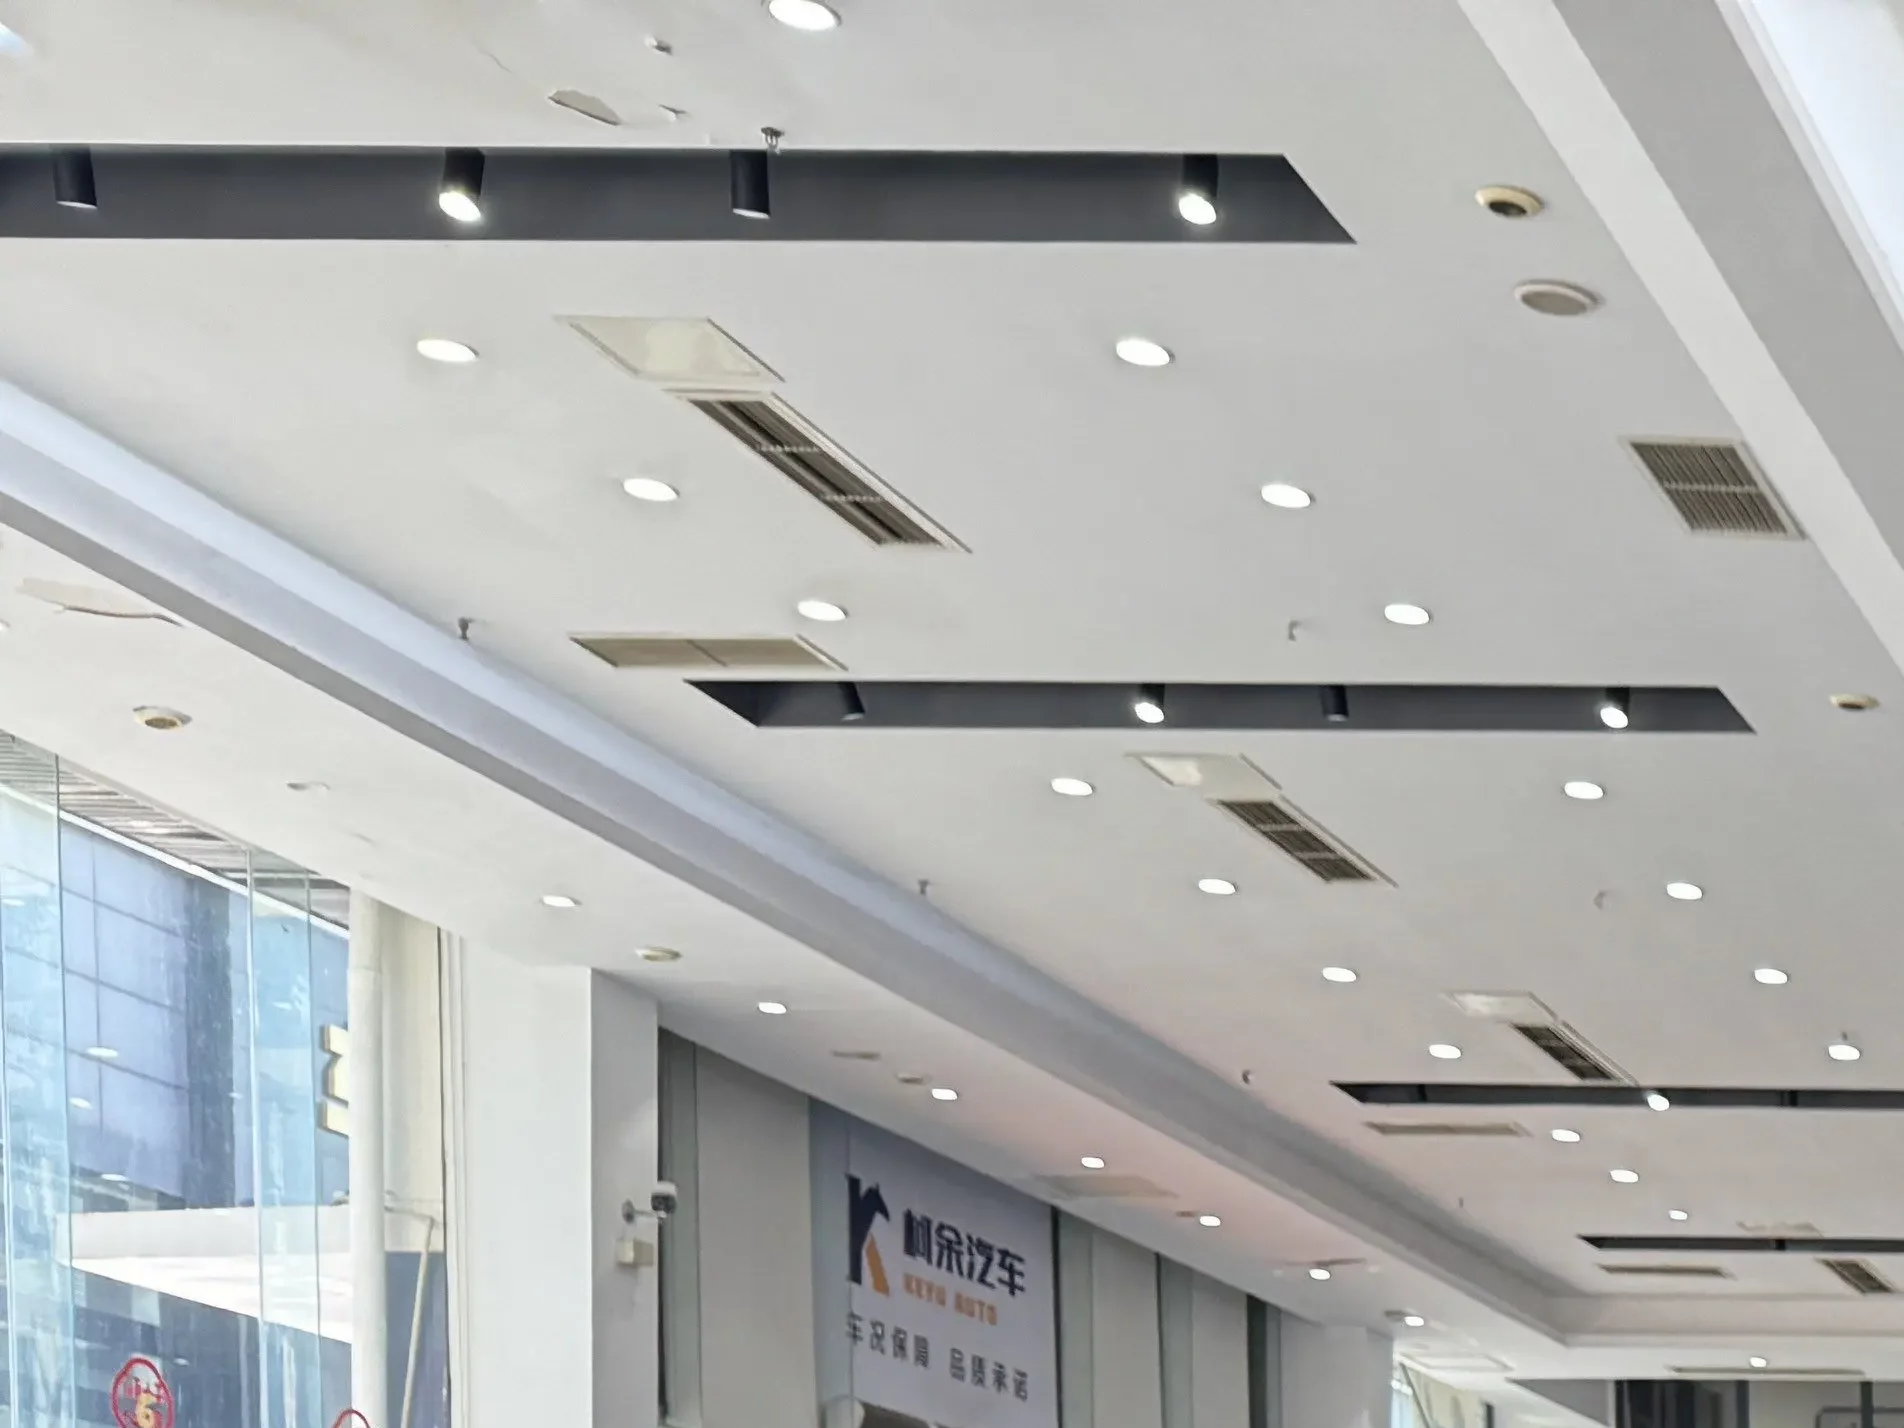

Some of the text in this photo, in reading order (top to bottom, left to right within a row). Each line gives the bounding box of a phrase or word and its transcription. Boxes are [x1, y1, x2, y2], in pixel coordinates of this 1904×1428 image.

[904, 1208, 1026, 1297] 柯余汽车
[846, 1312, 930, 1369] 车况保障
